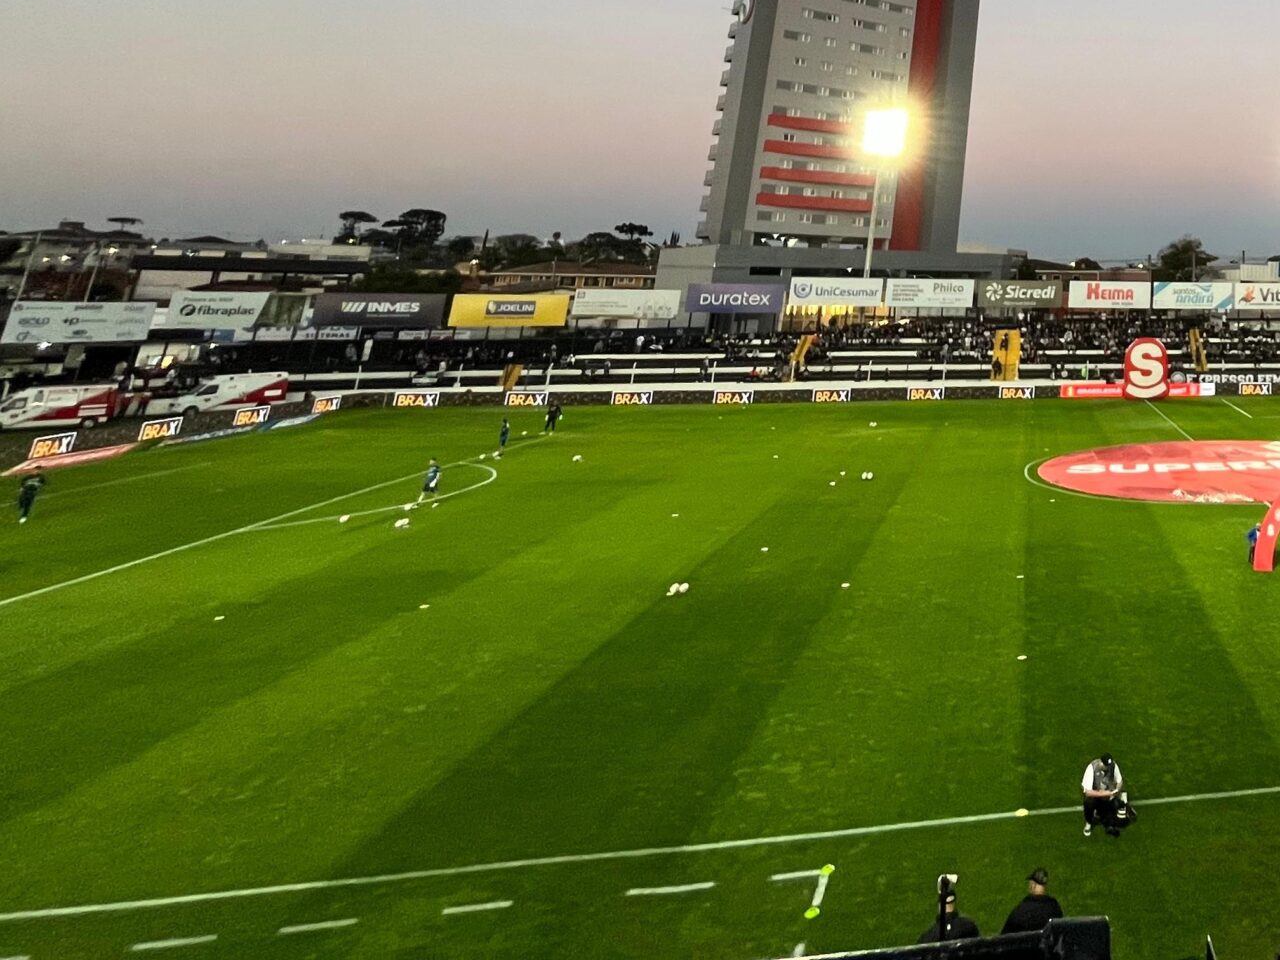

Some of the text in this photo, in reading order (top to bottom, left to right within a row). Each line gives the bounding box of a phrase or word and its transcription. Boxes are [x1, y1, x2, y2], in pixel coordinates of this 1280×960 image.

[815, 285, 880, 297] UniCesumar
[933, 282, 965, 294] Philco
[1005, 285, 1056, 298] Sicredi
[197, 304, 255, 317] fibraplac
[367, 302, 420, 313] INMES
[1129, 342, 1164, 387] S
[911, 388, 942, 400] BRAX
[1003, 388, 1032, 399] BRAX
[1242, 384, 1269, 395] BRAX
[397, 394, 436, 406] BRAX
[508, 394, 546, 406] BRAX
[614, 392, 650, 405] BRAX
[717, 393, 750, 404] BRAX
[816, 390, 848, 402] BRAX
[315, 398, 340, 412] BRAX
[237, 408, 268, 426] BRAX
[142, 420, 179, 440] BRAX
[33, 435, 71, 458] BRAX
